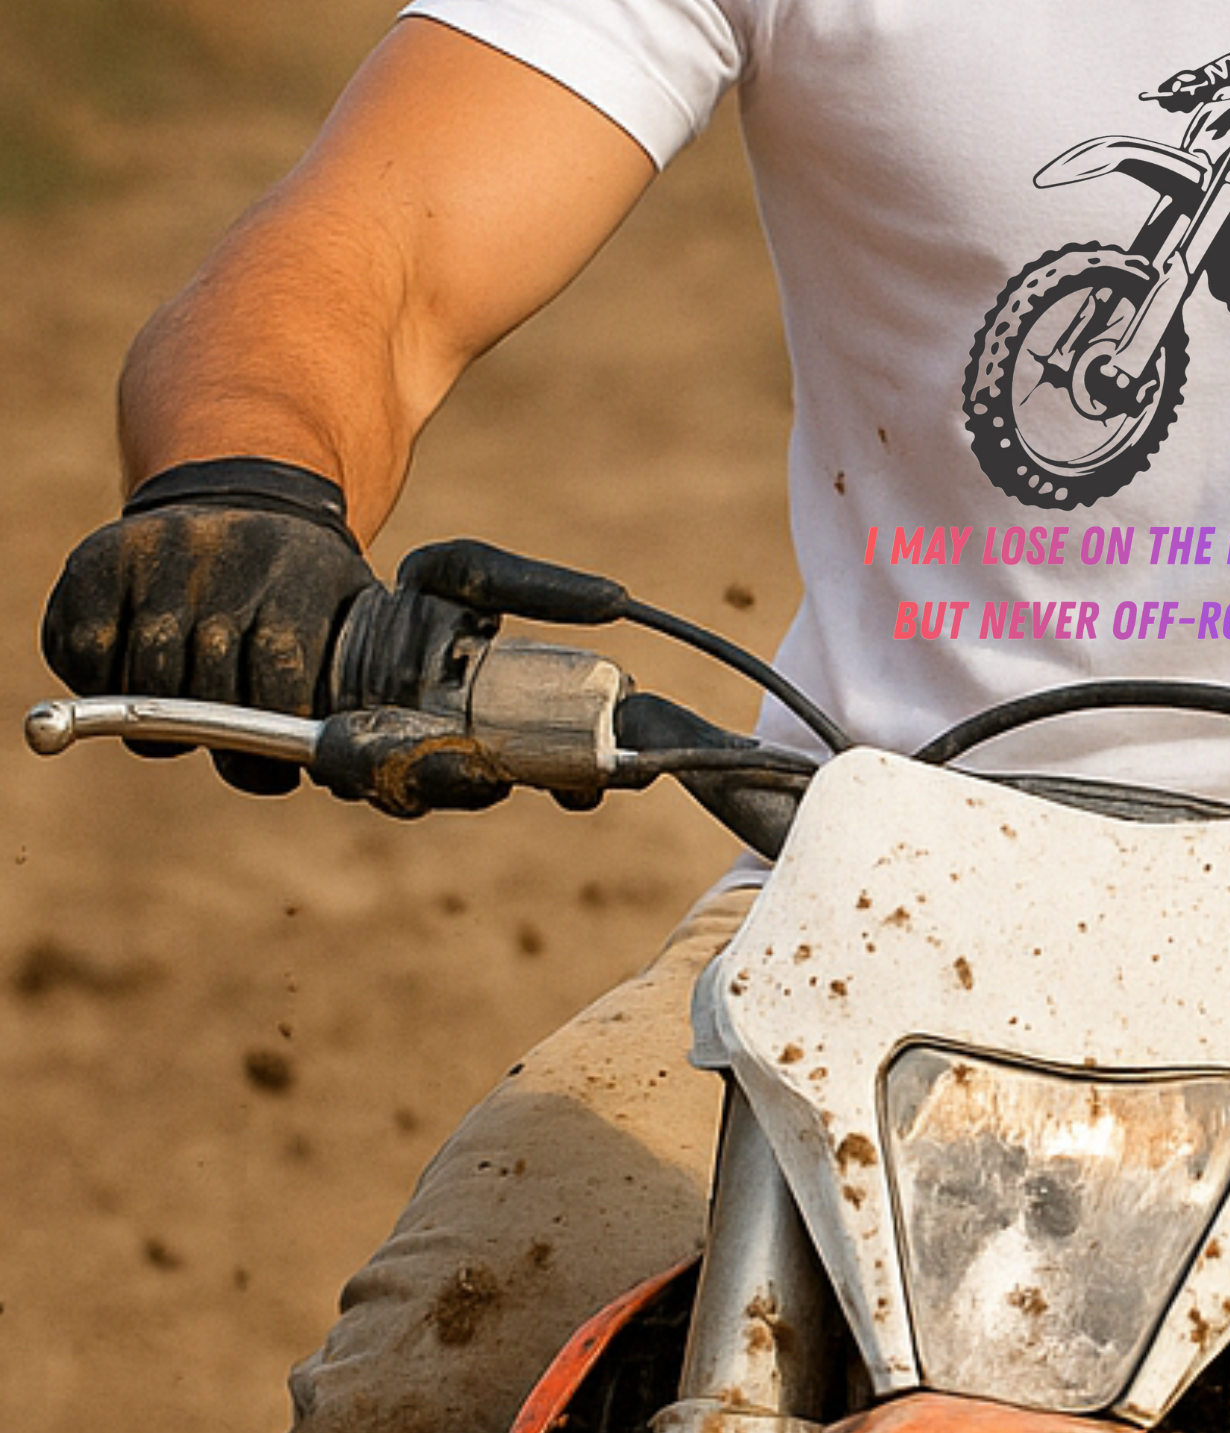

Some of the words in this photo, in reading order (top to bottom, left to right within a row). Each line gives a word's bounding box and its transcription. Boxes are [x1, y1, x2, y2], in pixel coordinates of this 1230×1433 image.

[863, 526, 879, 565] I
[890, 526, 973, 565] MAY
[982, 525, 1070, 565] LOSE
[1080, 525, 1135, 566] ON
[1149, 526, 1217, 565] THE
[893, 600, 970, 640] BUT
[978, 601, 1100, 640] NEVER
